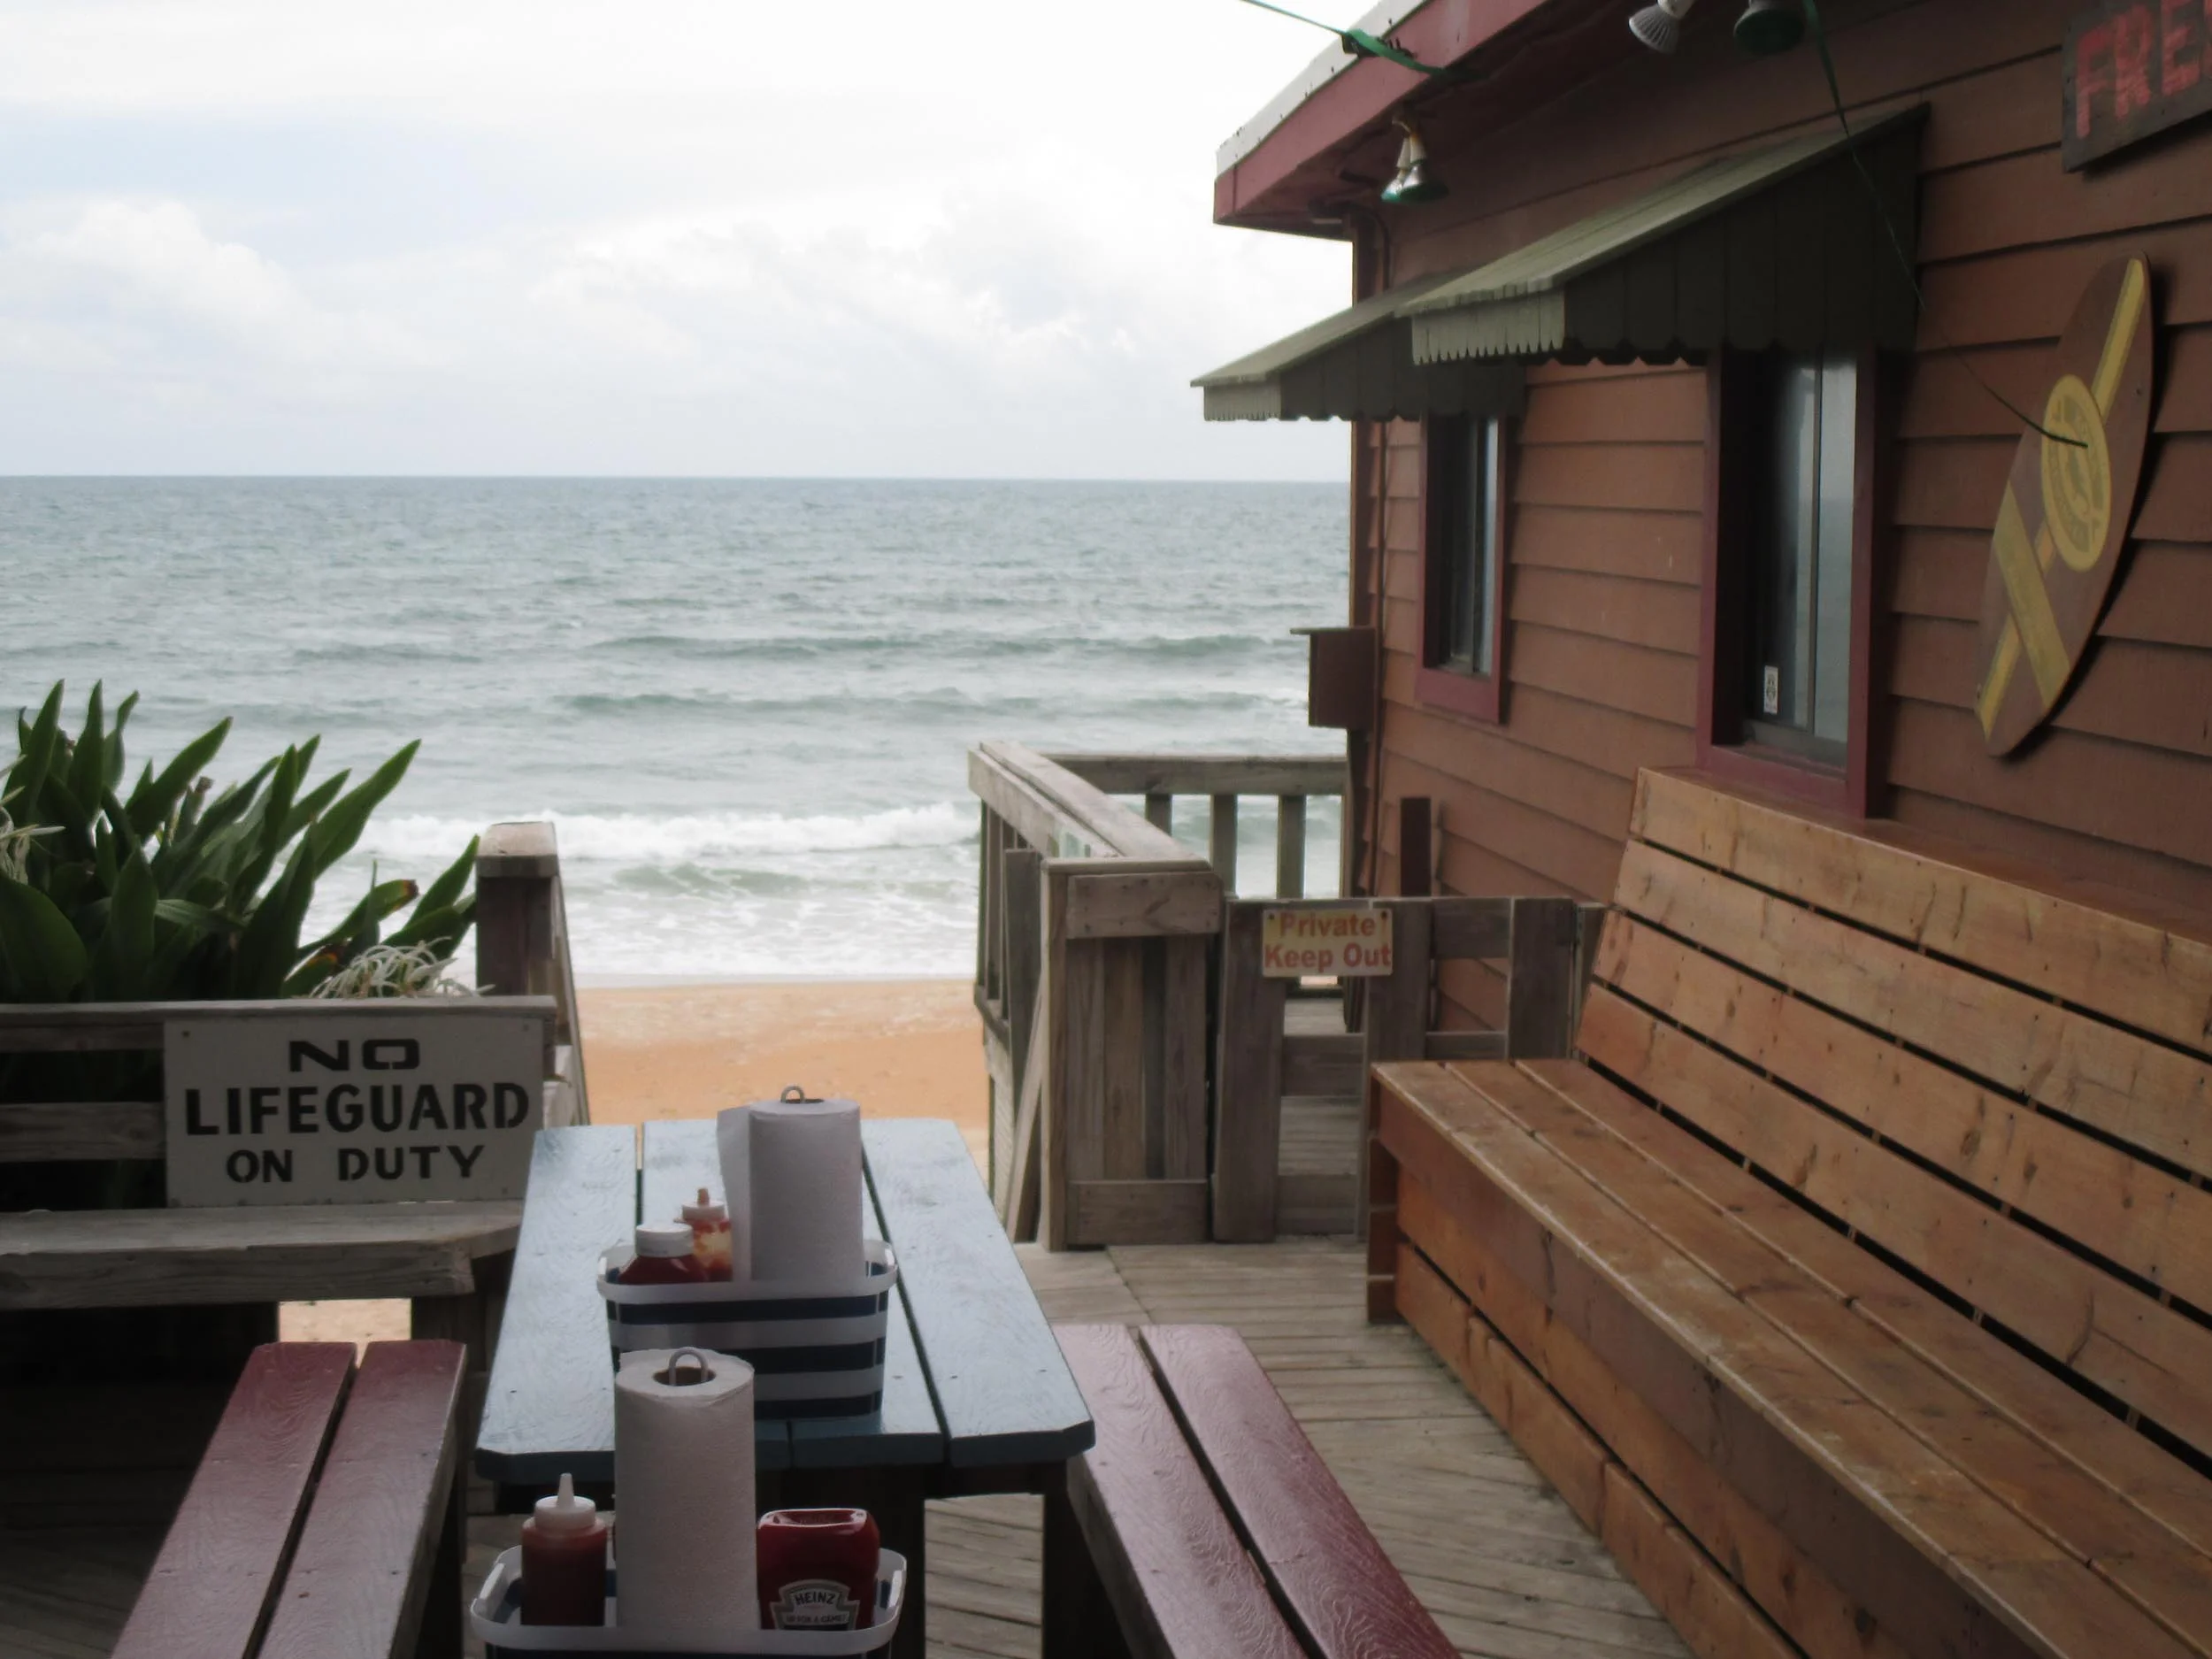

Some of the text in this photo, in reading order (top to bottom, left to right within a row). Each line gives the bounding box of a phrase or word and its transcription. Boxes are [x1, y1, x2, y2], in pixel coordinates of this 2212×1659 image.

[2076, 0, 2212, 139] FRE
[1279, 912, 1376, 938] Private
[1264, 942, 1392, 972] Keep Out
[288, 1038, 421, 1072] NO
[185, 1082, 529, 1136] LIFEGUARD
[226, 1145, 485, 1183] ON DUTY
[795, 1592, 836, 1605] HEINZ
